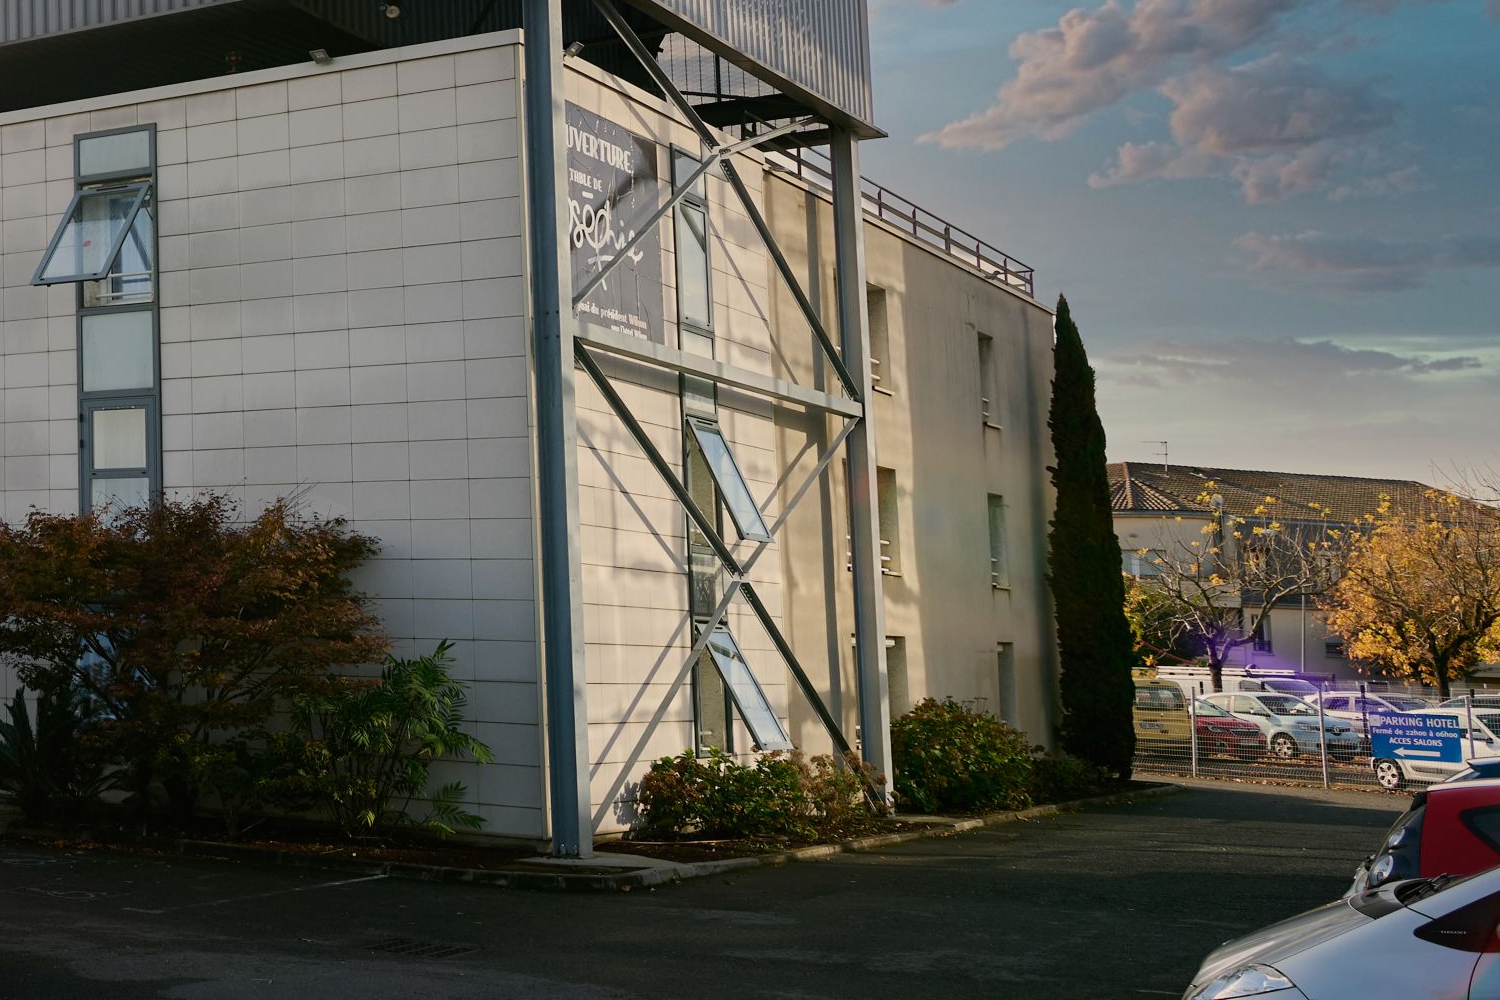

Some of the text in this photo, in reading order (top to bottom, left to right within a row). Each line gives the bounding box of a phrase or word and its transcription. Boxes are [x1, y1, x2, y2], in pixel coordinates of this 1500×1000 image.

[565, 123, 632, 174] UVERTURE
[569, 167, 603, 193] TABLE DE
[590, 302, 600, 315] du
[1380, 716, 1459, 729] PARKING HOTEL
[1372, 726, 1393, 735] Fermé
[1388, 736, 1443, 747] ACCES SALONS
